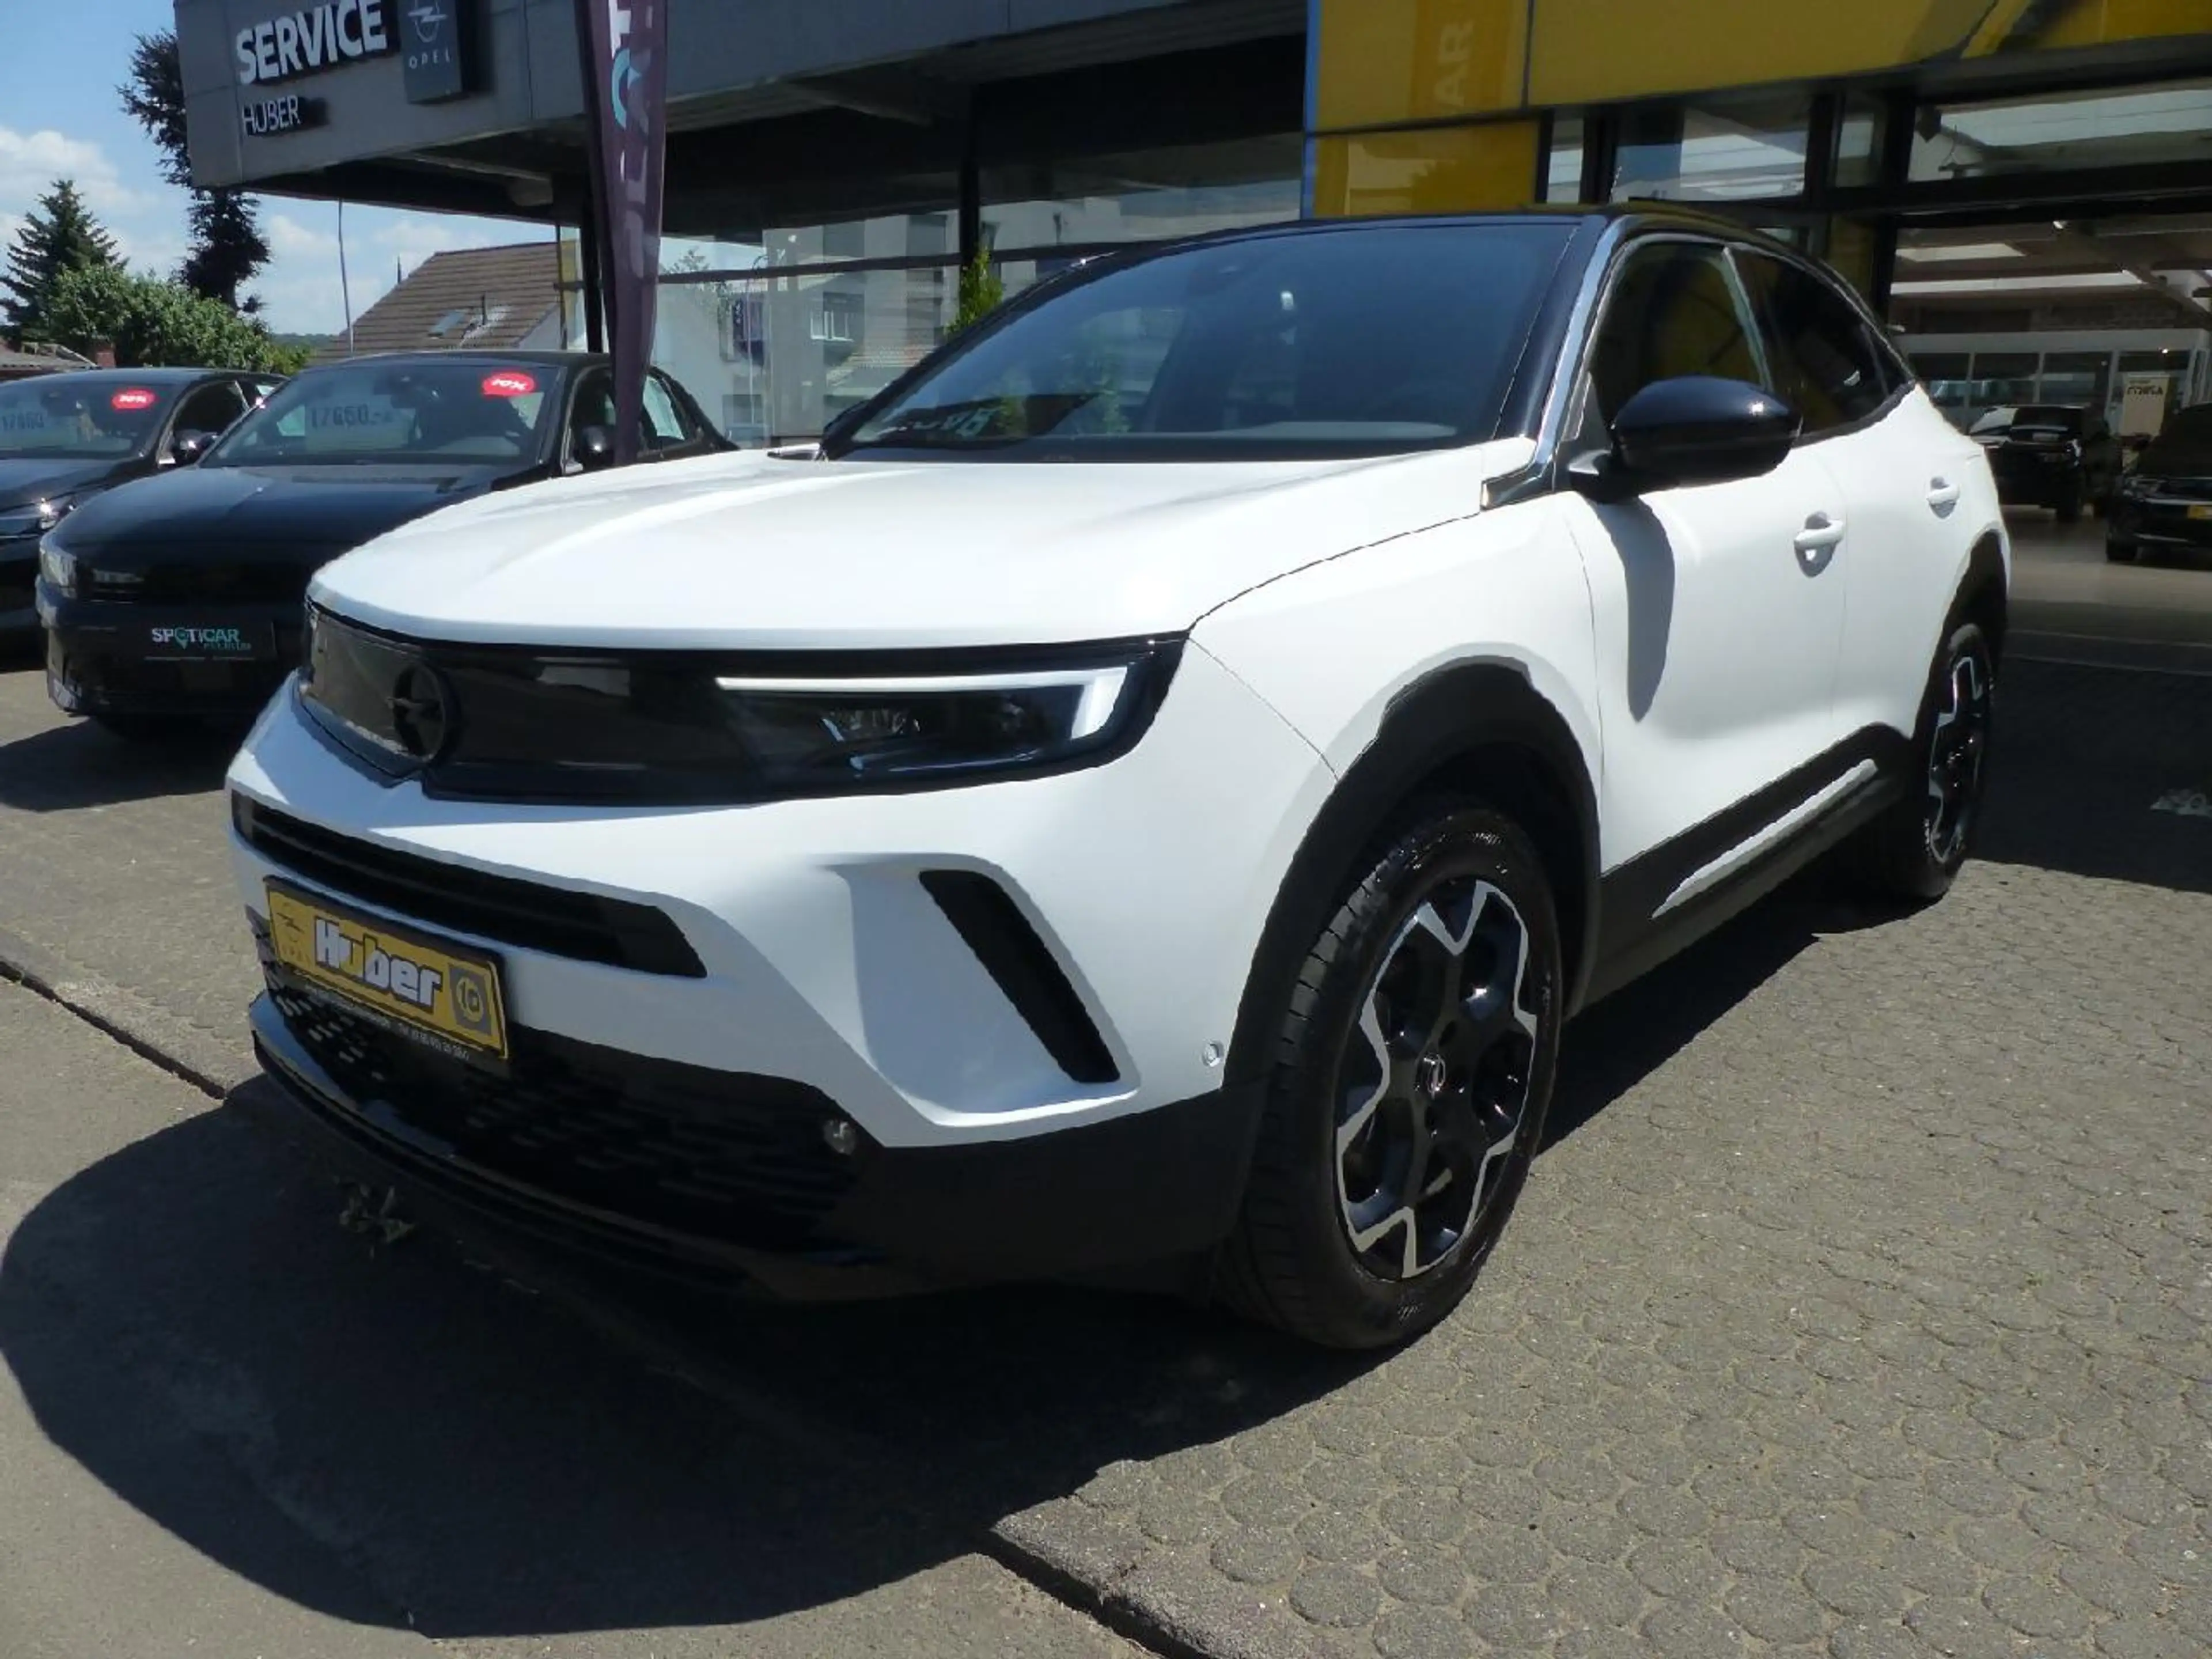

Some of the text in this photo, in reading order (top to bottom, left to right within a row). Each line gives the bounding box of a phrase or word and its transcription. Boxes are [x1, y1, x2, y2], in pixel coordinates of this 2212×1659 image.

[236, 0, 388, 84] SERVICE
[408, 47, 451, 70] OPEL
[242, 94, 301, 135] HUBER
[151, 627, 241, 650] SPOTICAR
[315, 916, 443, 1013] Huber
